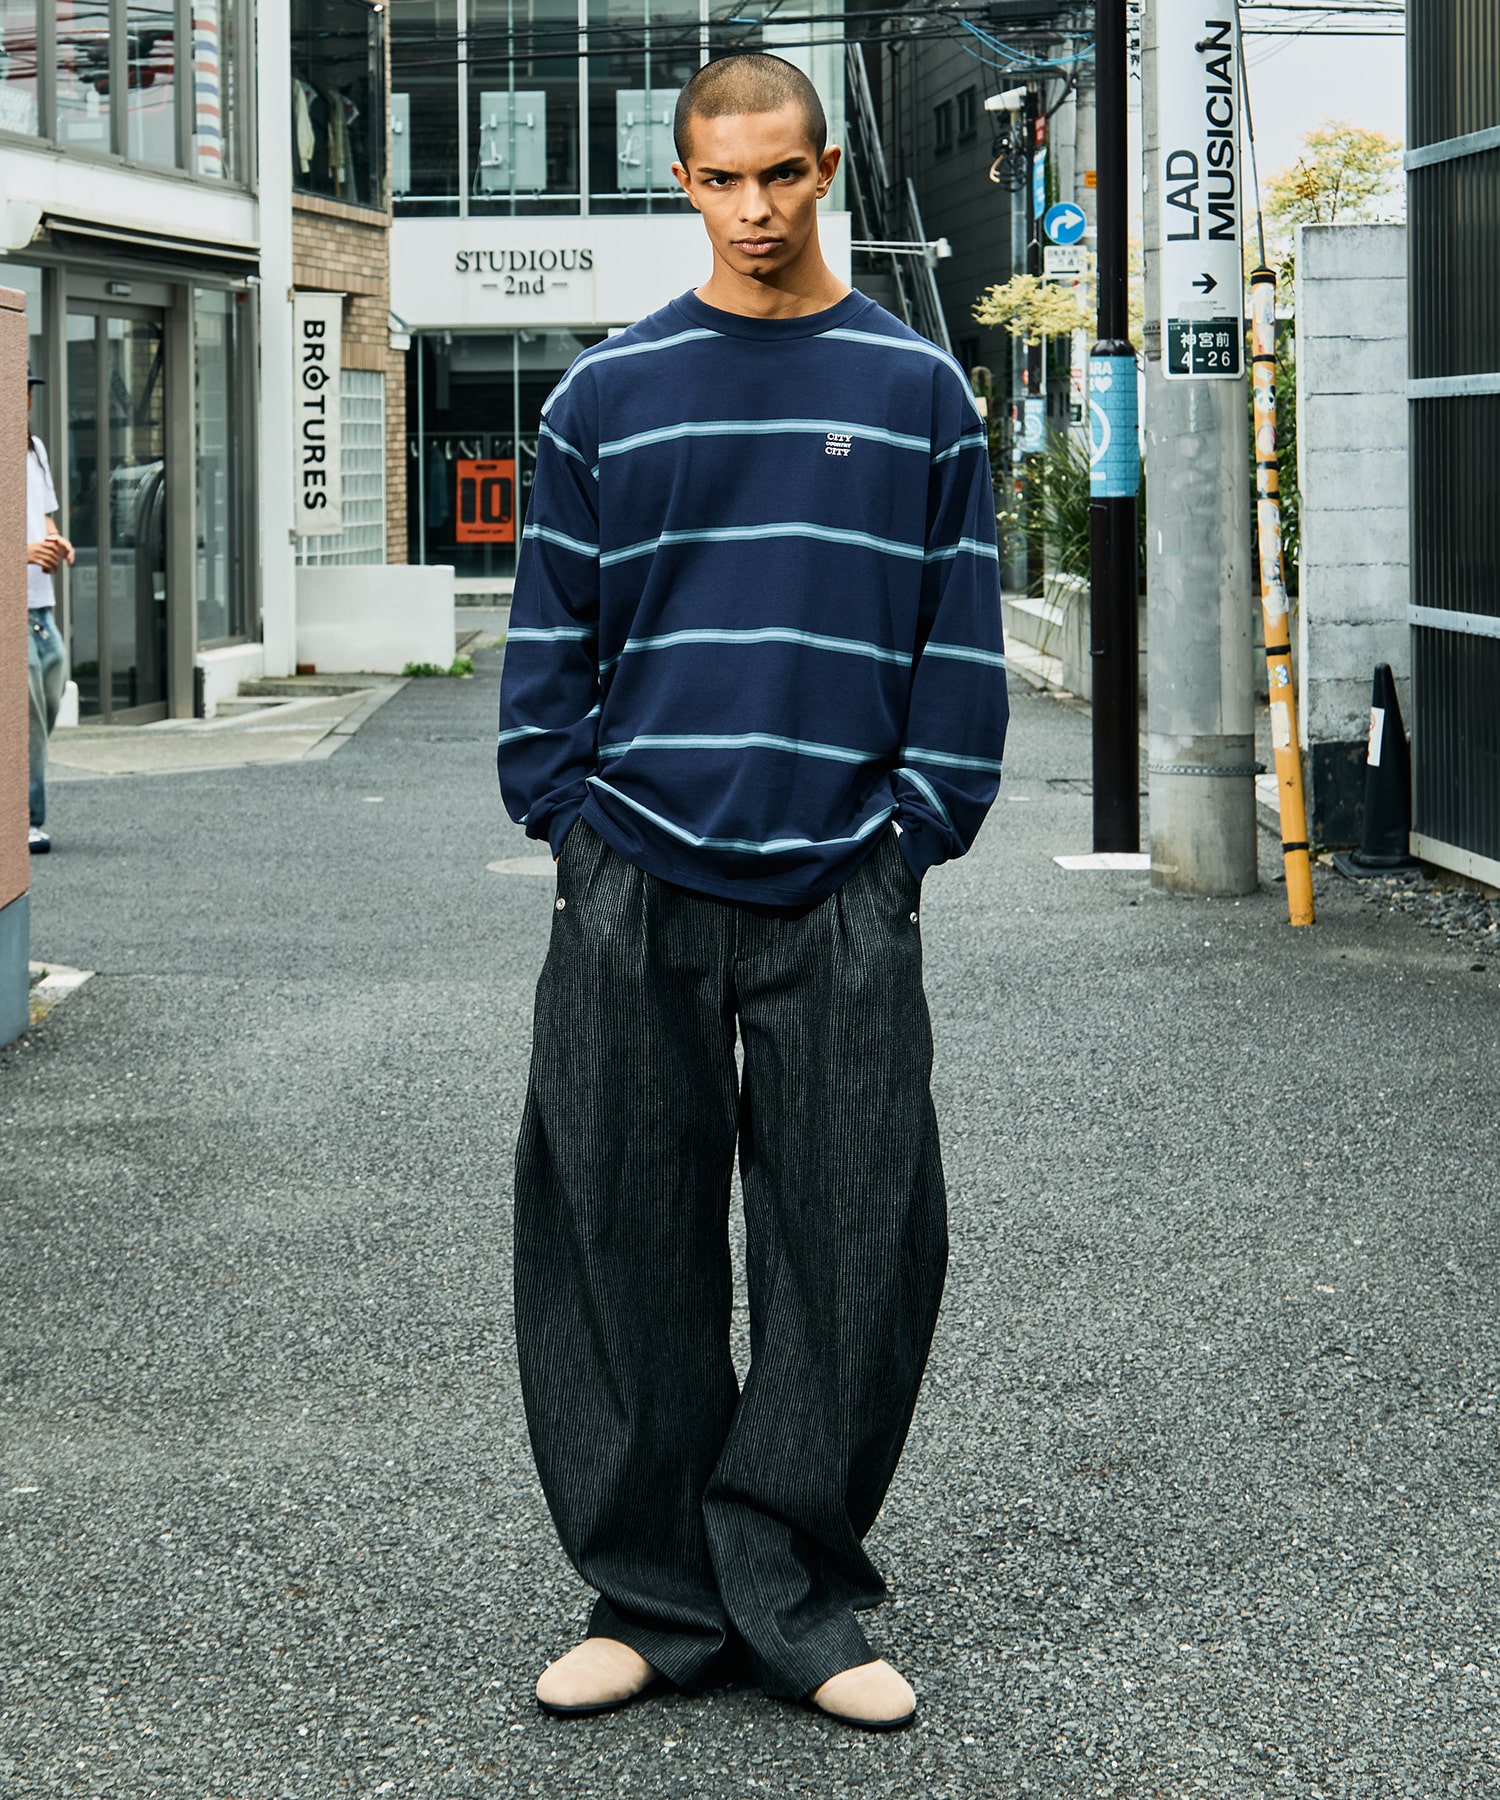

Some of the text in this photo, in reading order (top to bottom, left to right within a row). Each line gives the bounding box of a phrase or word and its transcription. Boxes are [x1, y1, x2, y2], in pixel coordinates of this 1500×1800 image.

[1205, 20, 1235, 240] MUSICIAN
[1166, 150, 1200, 241] LAD
[455, 249, 593, 272] STUDIOUS
[1180, 332, 1230, 348] 神宮前
[1181, 351, 1231, 367] 4-26
[826, 432, 853, 442] CITY
[825, 446, 851, 456] CITY
